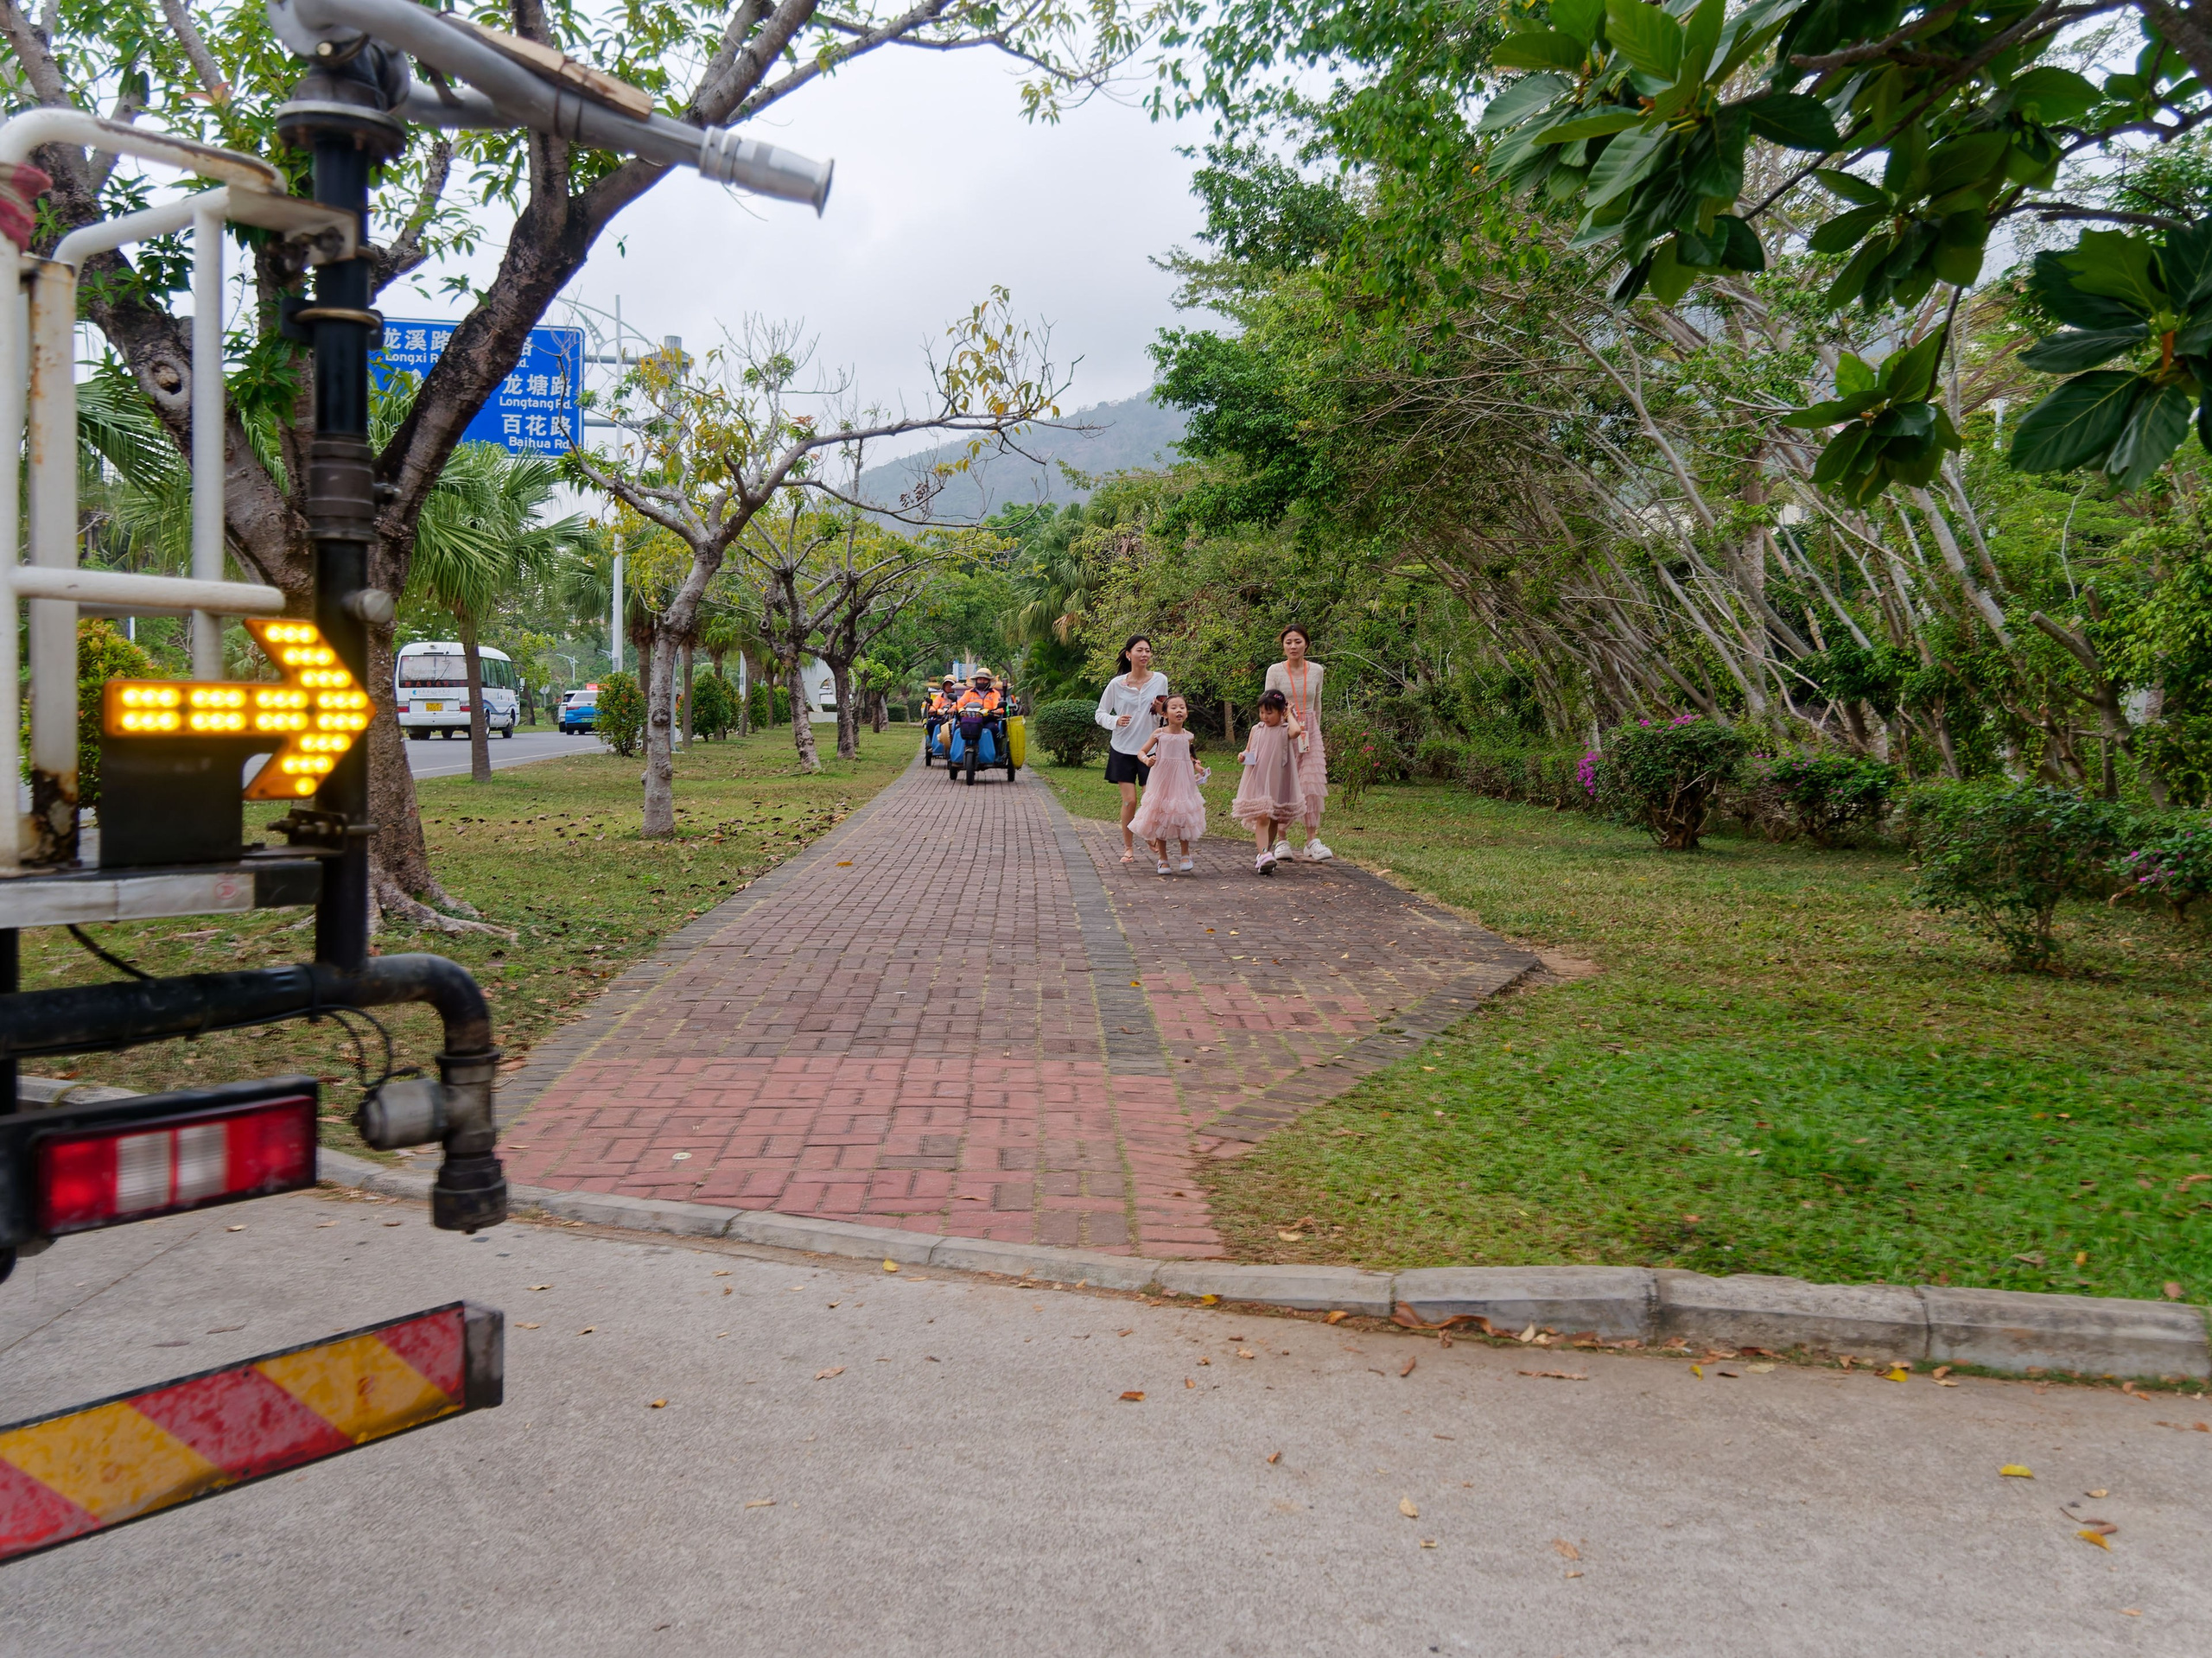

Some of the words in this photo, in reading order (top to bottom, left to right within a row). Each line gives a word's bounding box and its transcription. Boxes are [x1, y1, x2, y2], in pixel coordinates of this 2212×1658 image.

[383, 327, 452, 353] 龙溪路
[385, 353, 427, 365] Longxi
[502, 373, 572, 397] 龙塘路
[499, 396, 553, 411] Longtang
[501, 414, 572, 437] 百花路
[509, 435, 550, 448] Baihua
